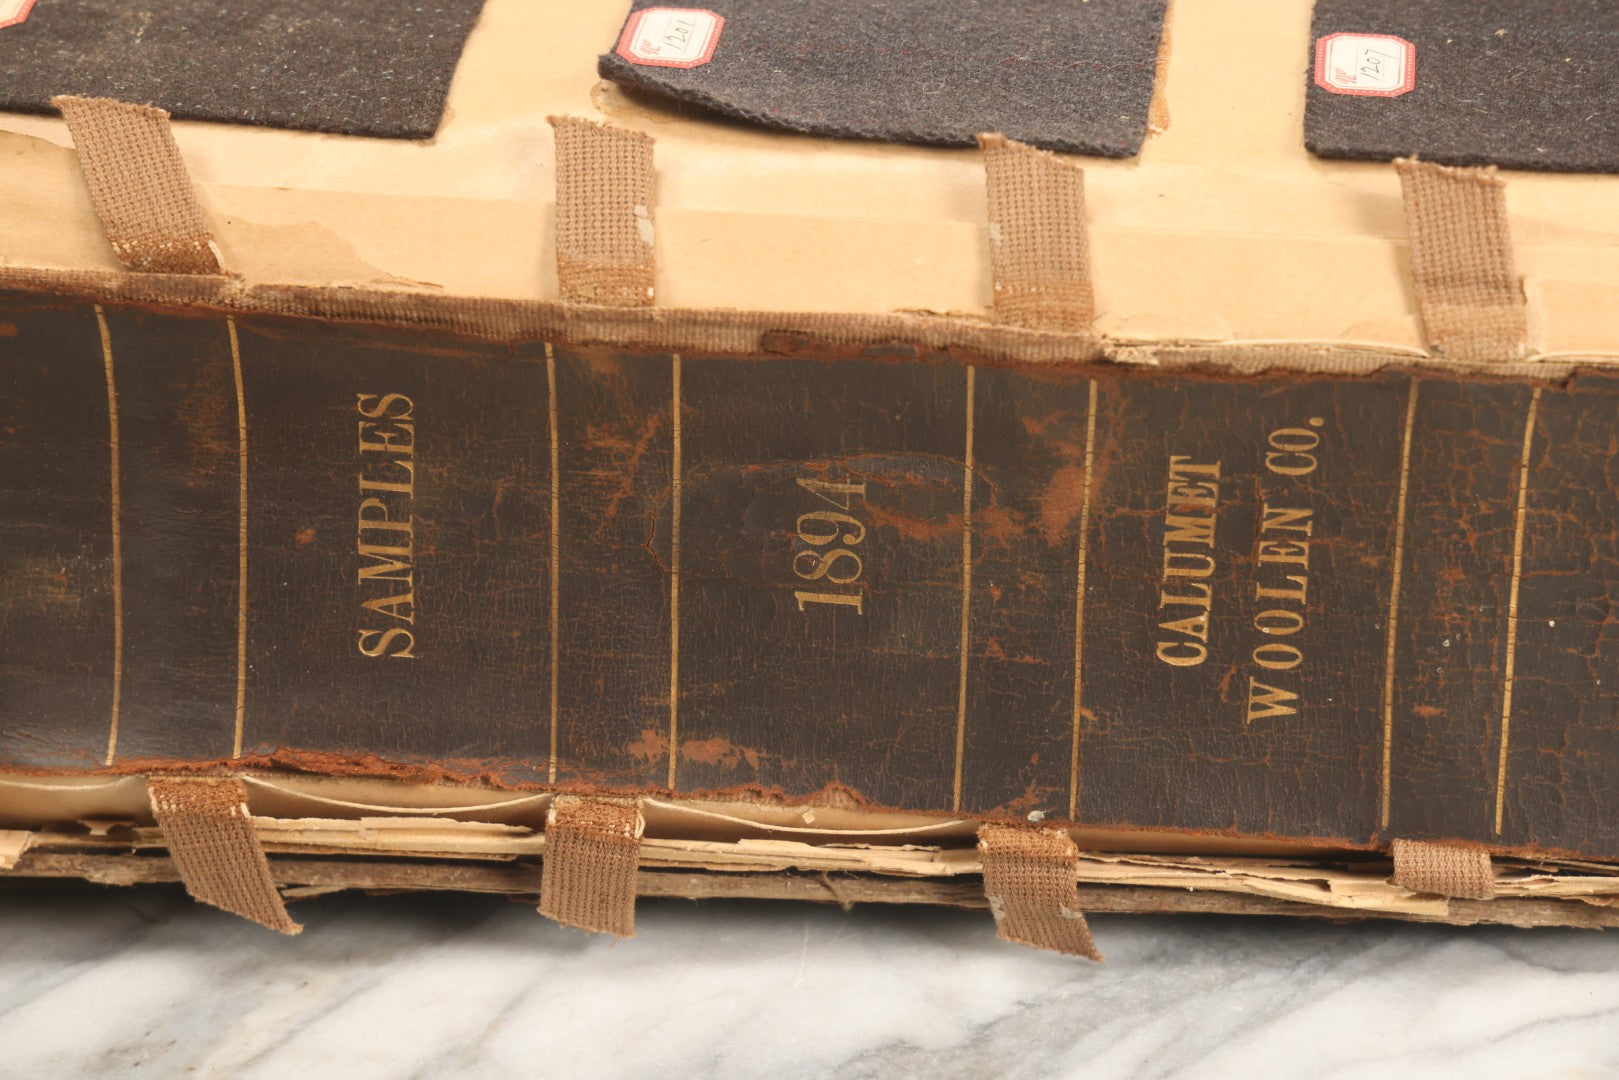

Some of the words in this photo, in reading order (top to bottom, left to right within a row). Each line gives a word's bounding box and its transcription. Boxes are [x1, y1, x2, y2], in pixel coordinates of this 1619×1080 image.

[664, 20, 695, 50] 1201
[1360, 48, 1401, 81] 1207
[1265, 416, 1325, 476] CO.
[357, 393, 415, 658] SAMPLES
[794, 475, 866, 615] 1894
[1156, 455, 1221, 667] CALUMET
[1247, 502, 1314, 724] WOOLEN
